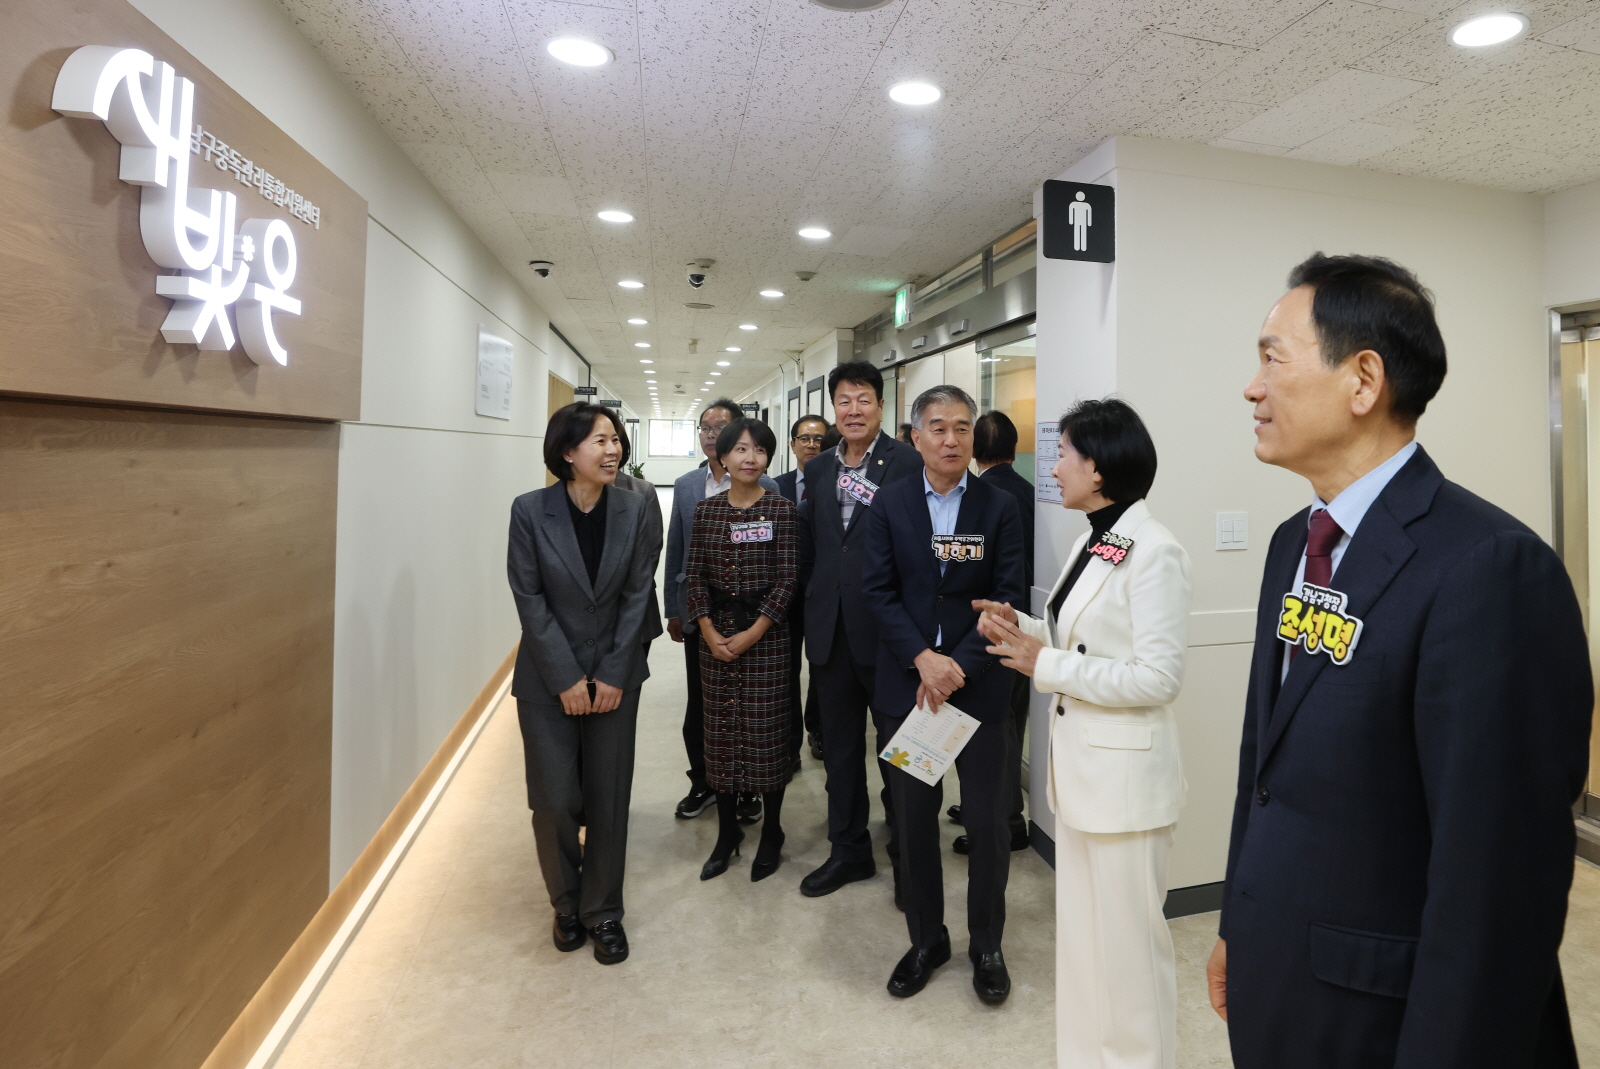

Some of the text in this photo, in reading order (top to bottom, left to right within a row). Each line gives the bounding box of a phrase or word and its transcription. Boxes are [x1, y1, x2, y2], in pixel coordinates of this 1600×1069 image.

[732, 527, 771, 542] 이도희
[1101, 531, 1133, 549] 국회의원
[1302, 587, 1341, 612] 강남구청장
[1279, 597, 1356, 660] 조성명
